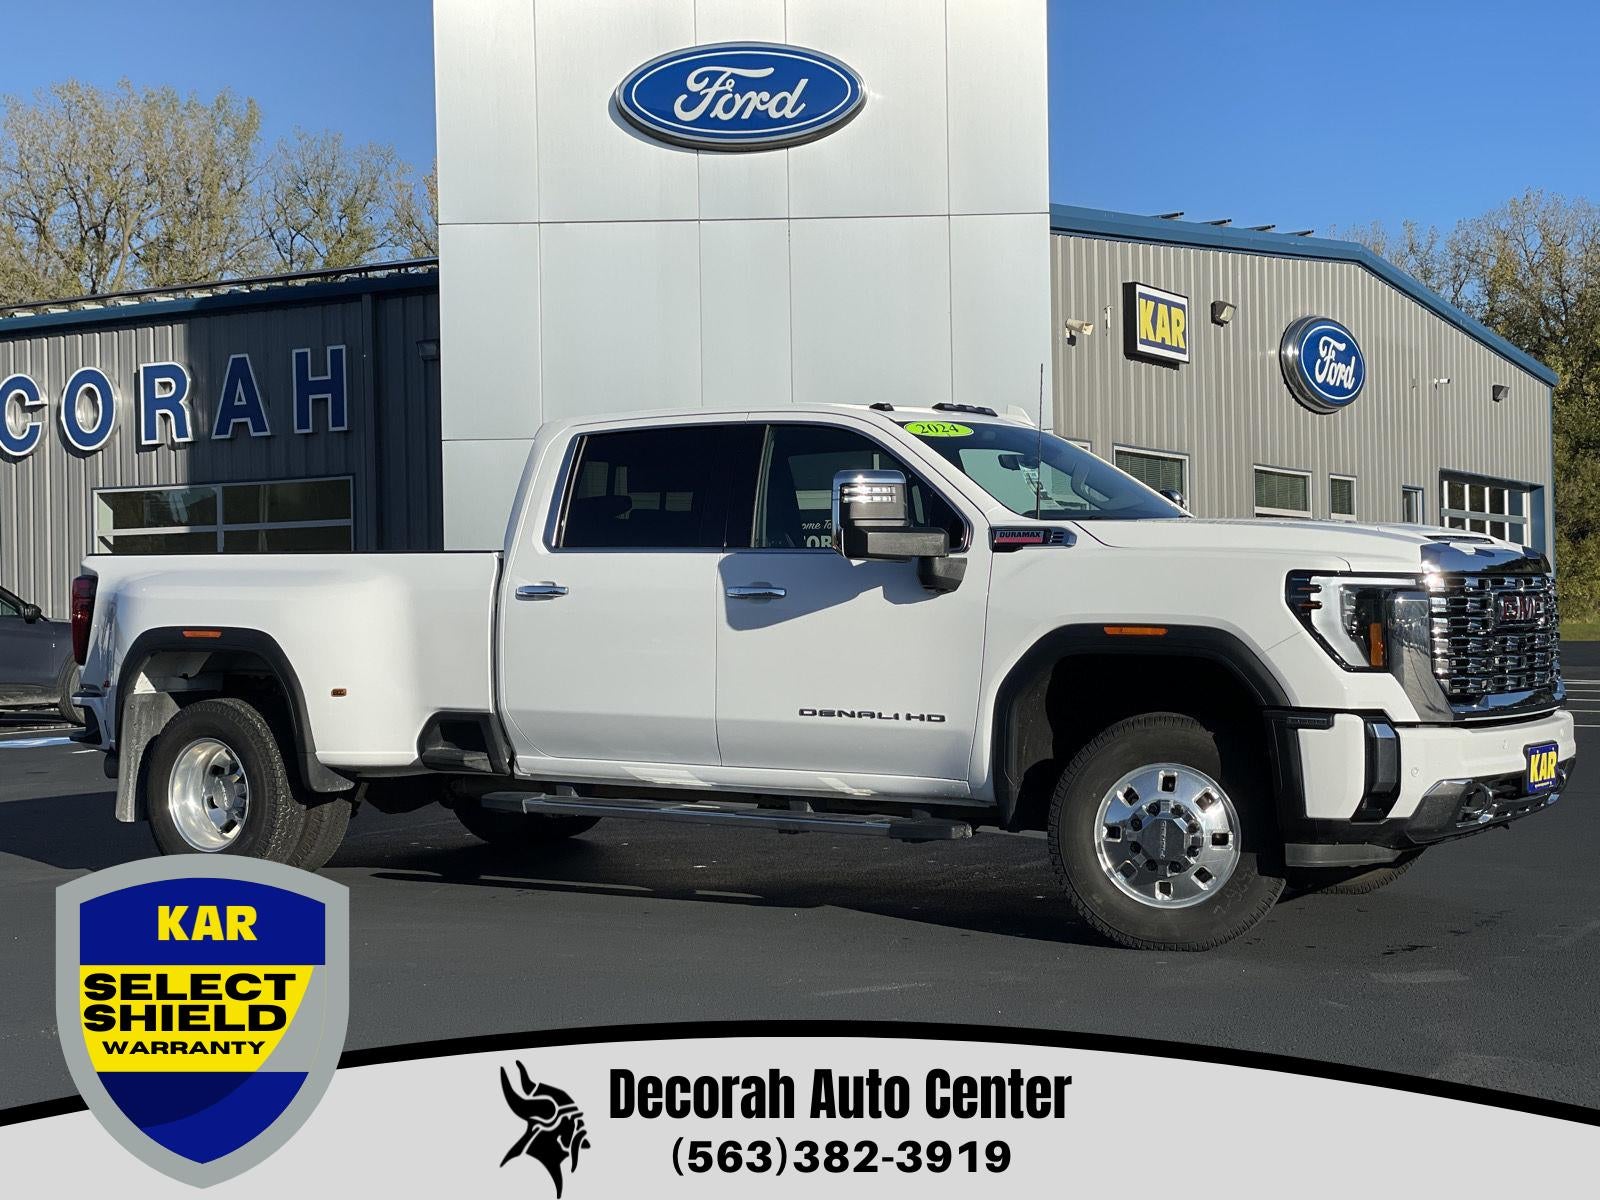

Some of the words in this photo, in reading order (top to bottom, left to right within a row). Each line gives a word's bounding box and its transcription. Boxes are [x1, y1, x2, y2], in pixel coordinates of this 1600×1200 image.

[673, 65, 809, 122] Ford
[1139, 298, 1186, 349] KAR
[1315, 335, 1356, 390] Ford
[0, 344, 349, 456] CORAH
[915, 423, 959, 434] 2024
[803, 535, 832, 547] OR
[1000, 530, 1042, 538] DURAMAX
[1499, 595, 1546, 621] GMC
[798, 708, 900, 721] DENALI
[905, 713, 946, 723] HD
[1530, 750, 1557, 783] KAR
